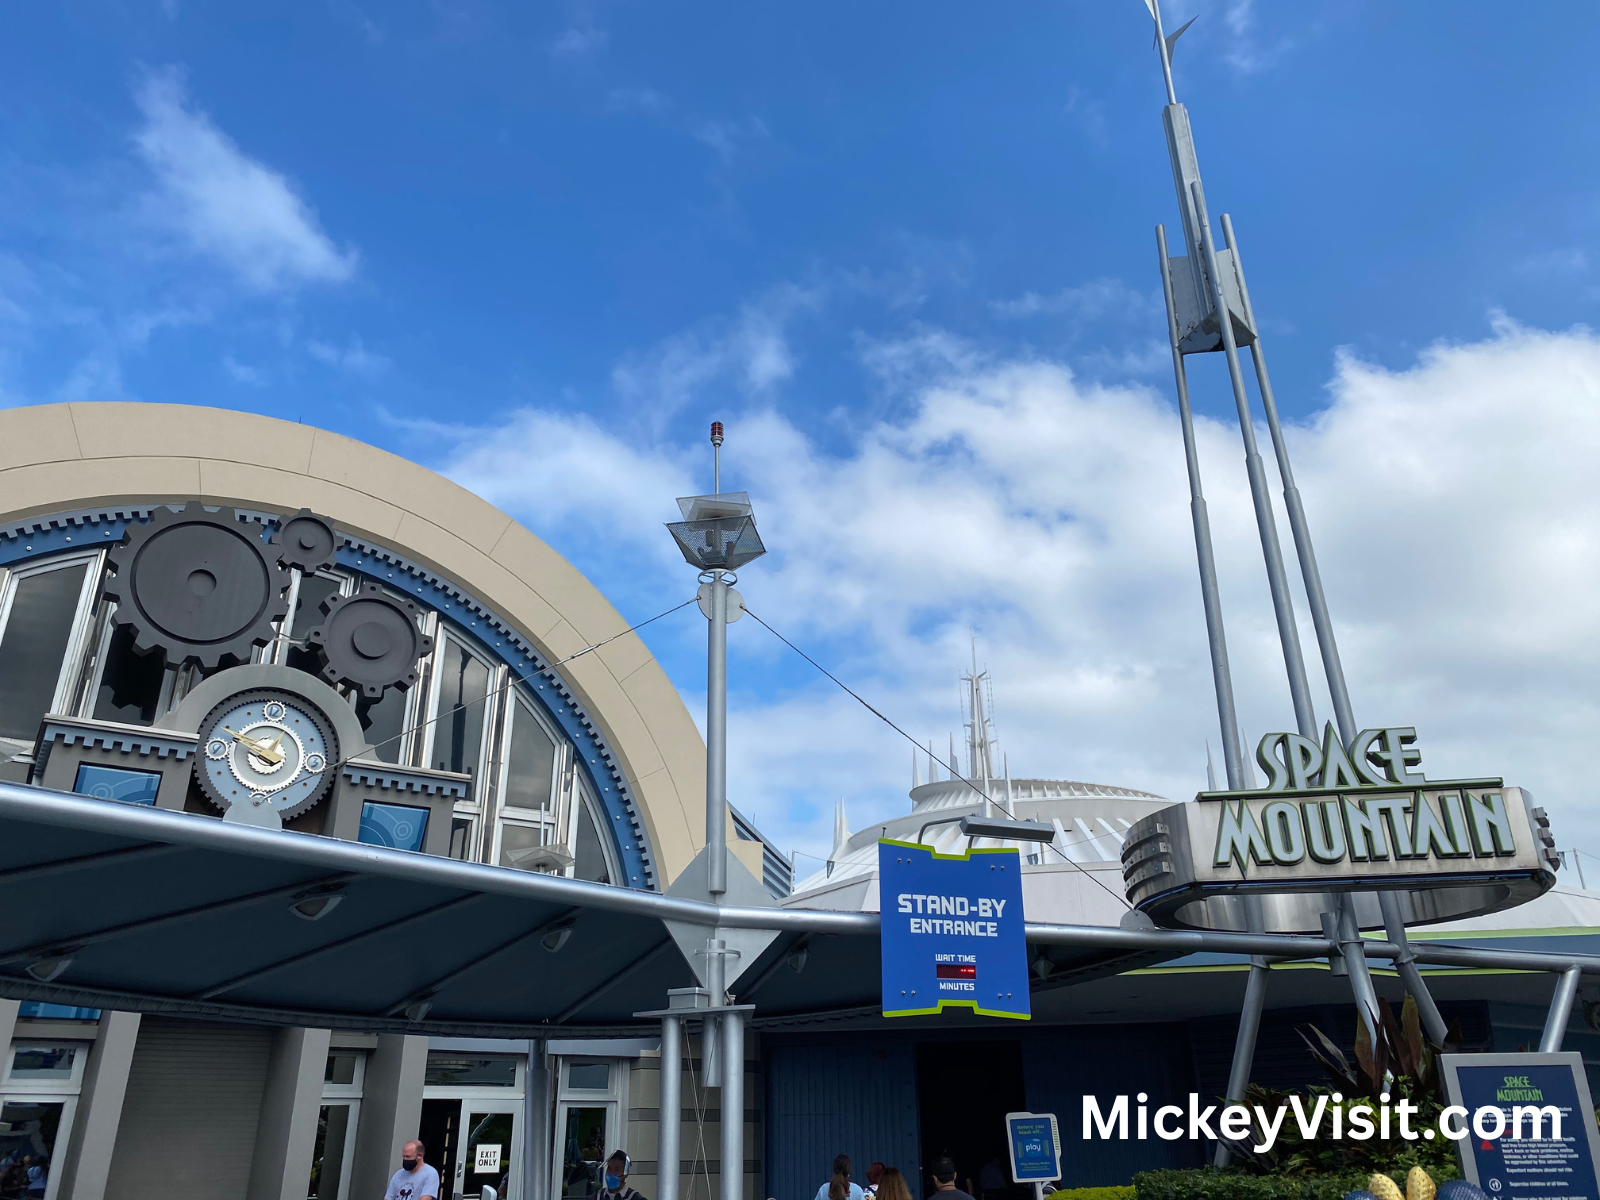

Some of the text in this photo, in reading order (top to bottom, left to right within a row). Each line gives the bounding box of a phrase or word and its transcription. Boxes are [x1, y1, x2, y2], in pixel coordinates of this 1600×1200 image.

[269, 705, 280, 717] 12
[212, 743, 222, 755] 9
[1255, 719, 1426, 791] SPACE
[310, 757, 319, 768] 3
[1213, 789, 1516, 879] MOUNTAIN
[897, 893, 1007, 918] STAND-BY
[910, 918, 998, 937] ENTRANCE
[935, 953, 976, 963] WAIT TIME
[939, 982, 975, 991] MINUTES
[1503, 1075, 1530, 1088] SPACE
[1496, 1088, 1544, 1102] MOUNTAIN
[1025, 1143, 1041, 1152] play
[480, 1150, 497, 1158] EXIT
[478, 1158, 497, 1167] ONLY
